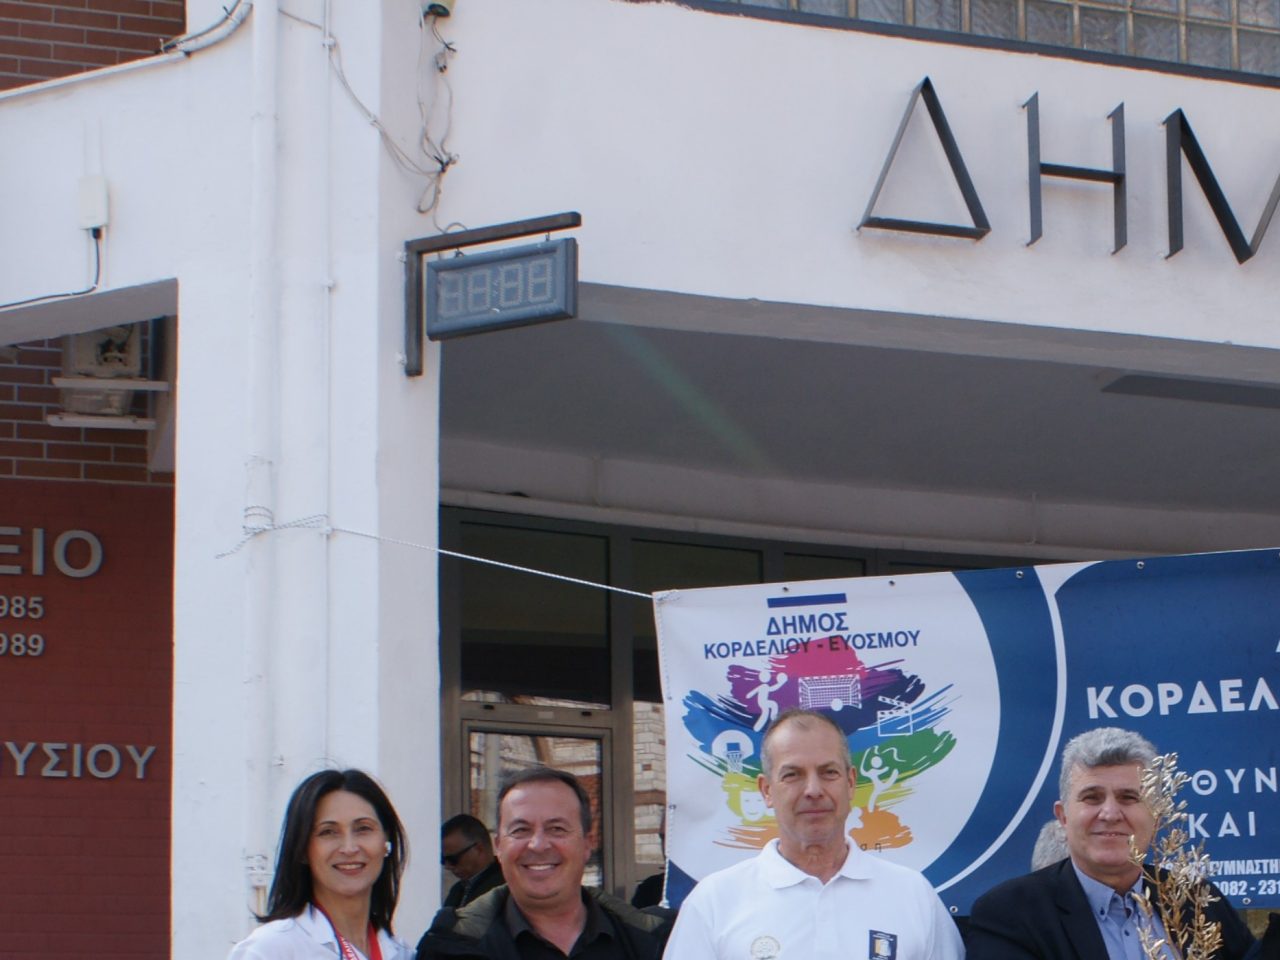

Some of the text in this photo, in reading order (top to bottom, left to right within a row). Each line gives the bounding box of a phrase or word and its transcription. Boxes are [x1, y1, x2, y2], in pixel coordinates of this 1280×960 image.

[0, 526, 103, 578] ΕΙΟ
[0, 595, 45, 619] 985
[766, 612, 849, 636] ΔΗΜΟΣ
[0, 633, 45, 657] 989
[704, 637, 811, 659] ΚΟΡΔΕΛΙΟΥ
[829, 630, 921, 652] ΕΥΟΣΜΟΥ
[5, 742, 155, 779] ΥΣΙΟΥ
[1188, 811, 1256, 839] ΚΑΙ
